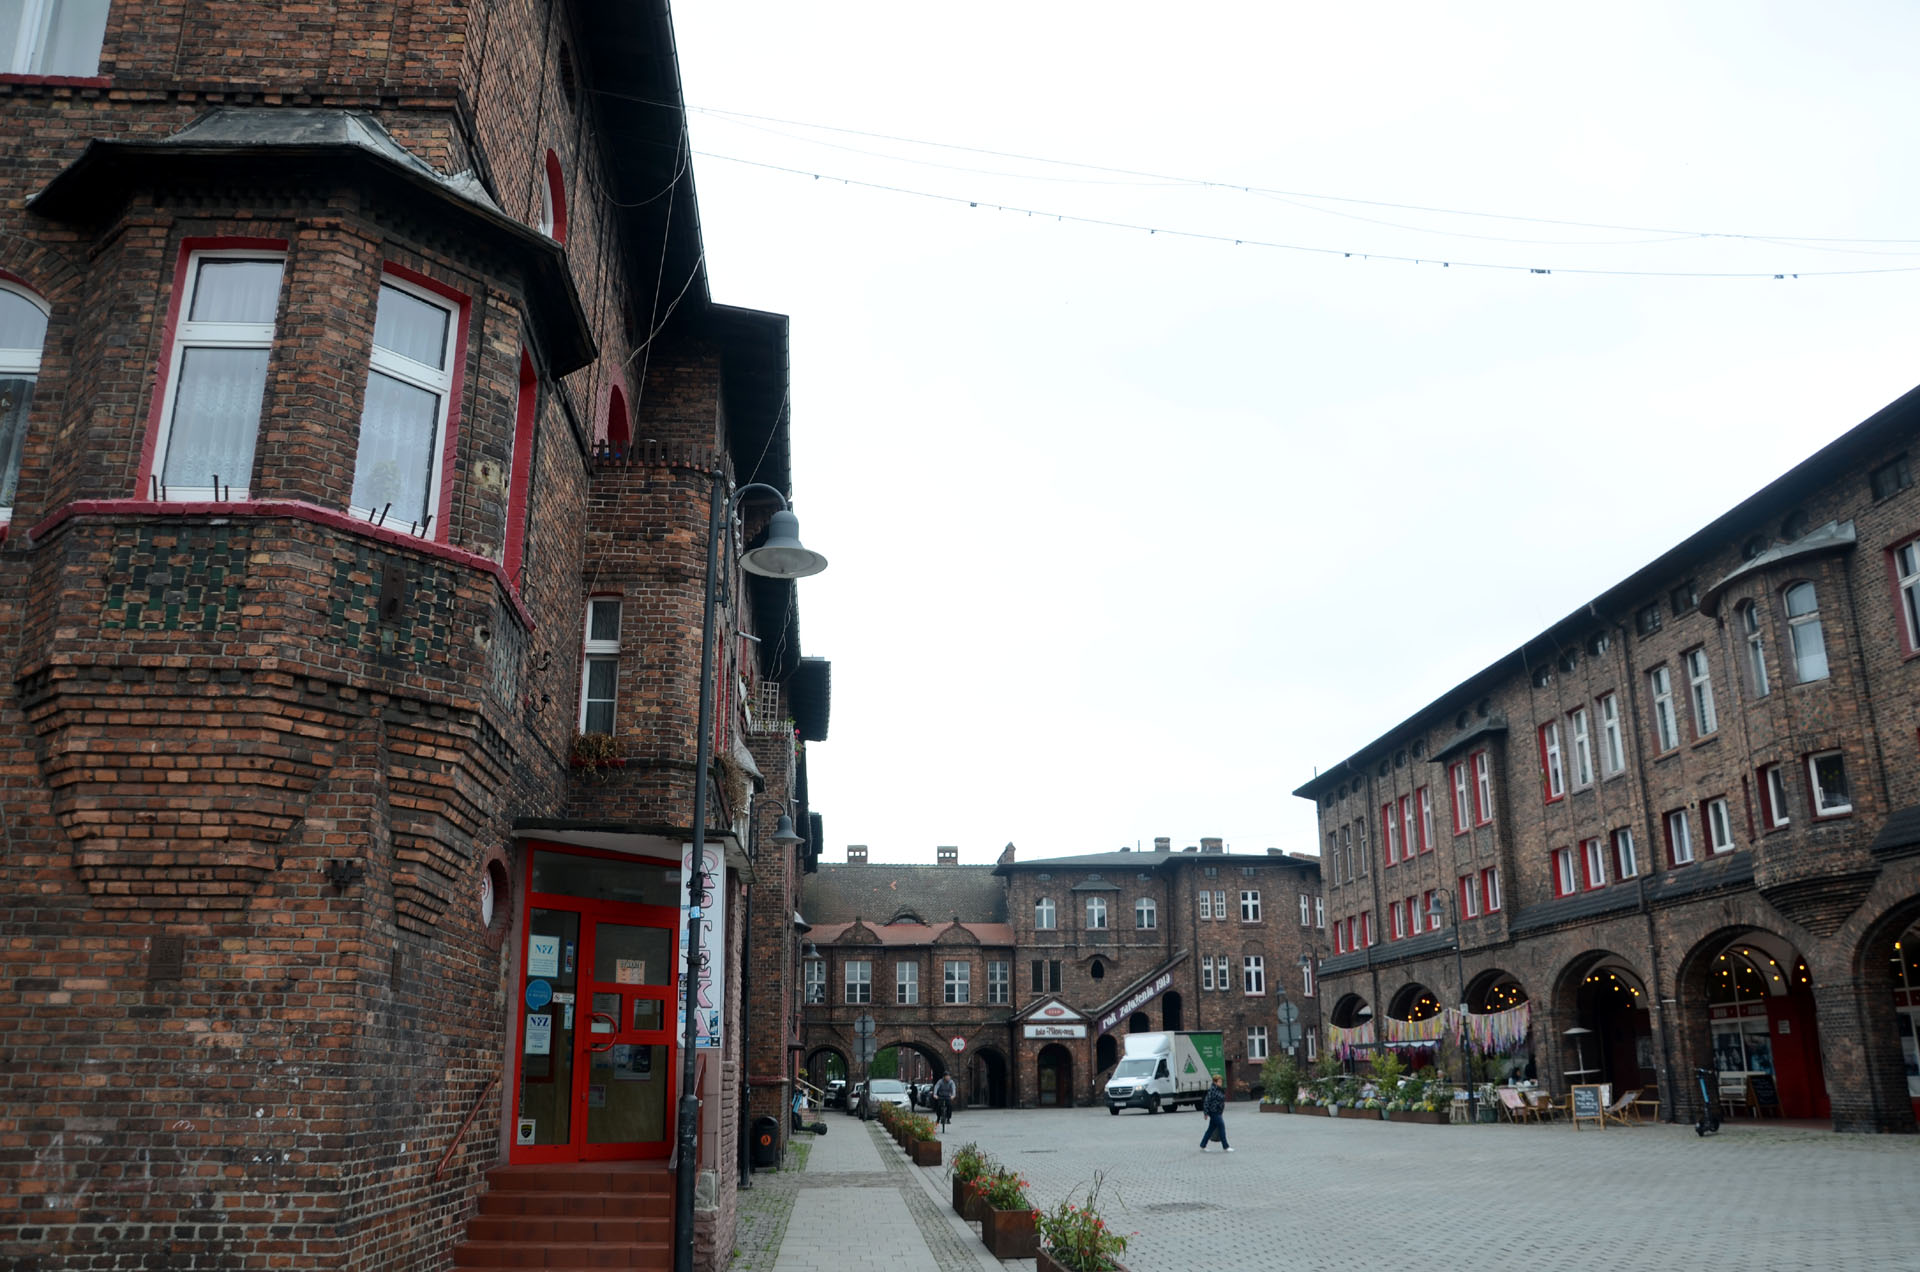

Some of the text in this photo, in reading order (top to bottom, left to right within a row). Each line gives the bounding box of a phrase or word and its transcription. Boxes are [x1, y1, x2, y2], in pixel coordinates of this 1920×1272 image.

[536, 943, 553, 954] NFZ
[530, 1016, 549, 1026] NFZ
[1103, 1012, 1117, 1029] rok
